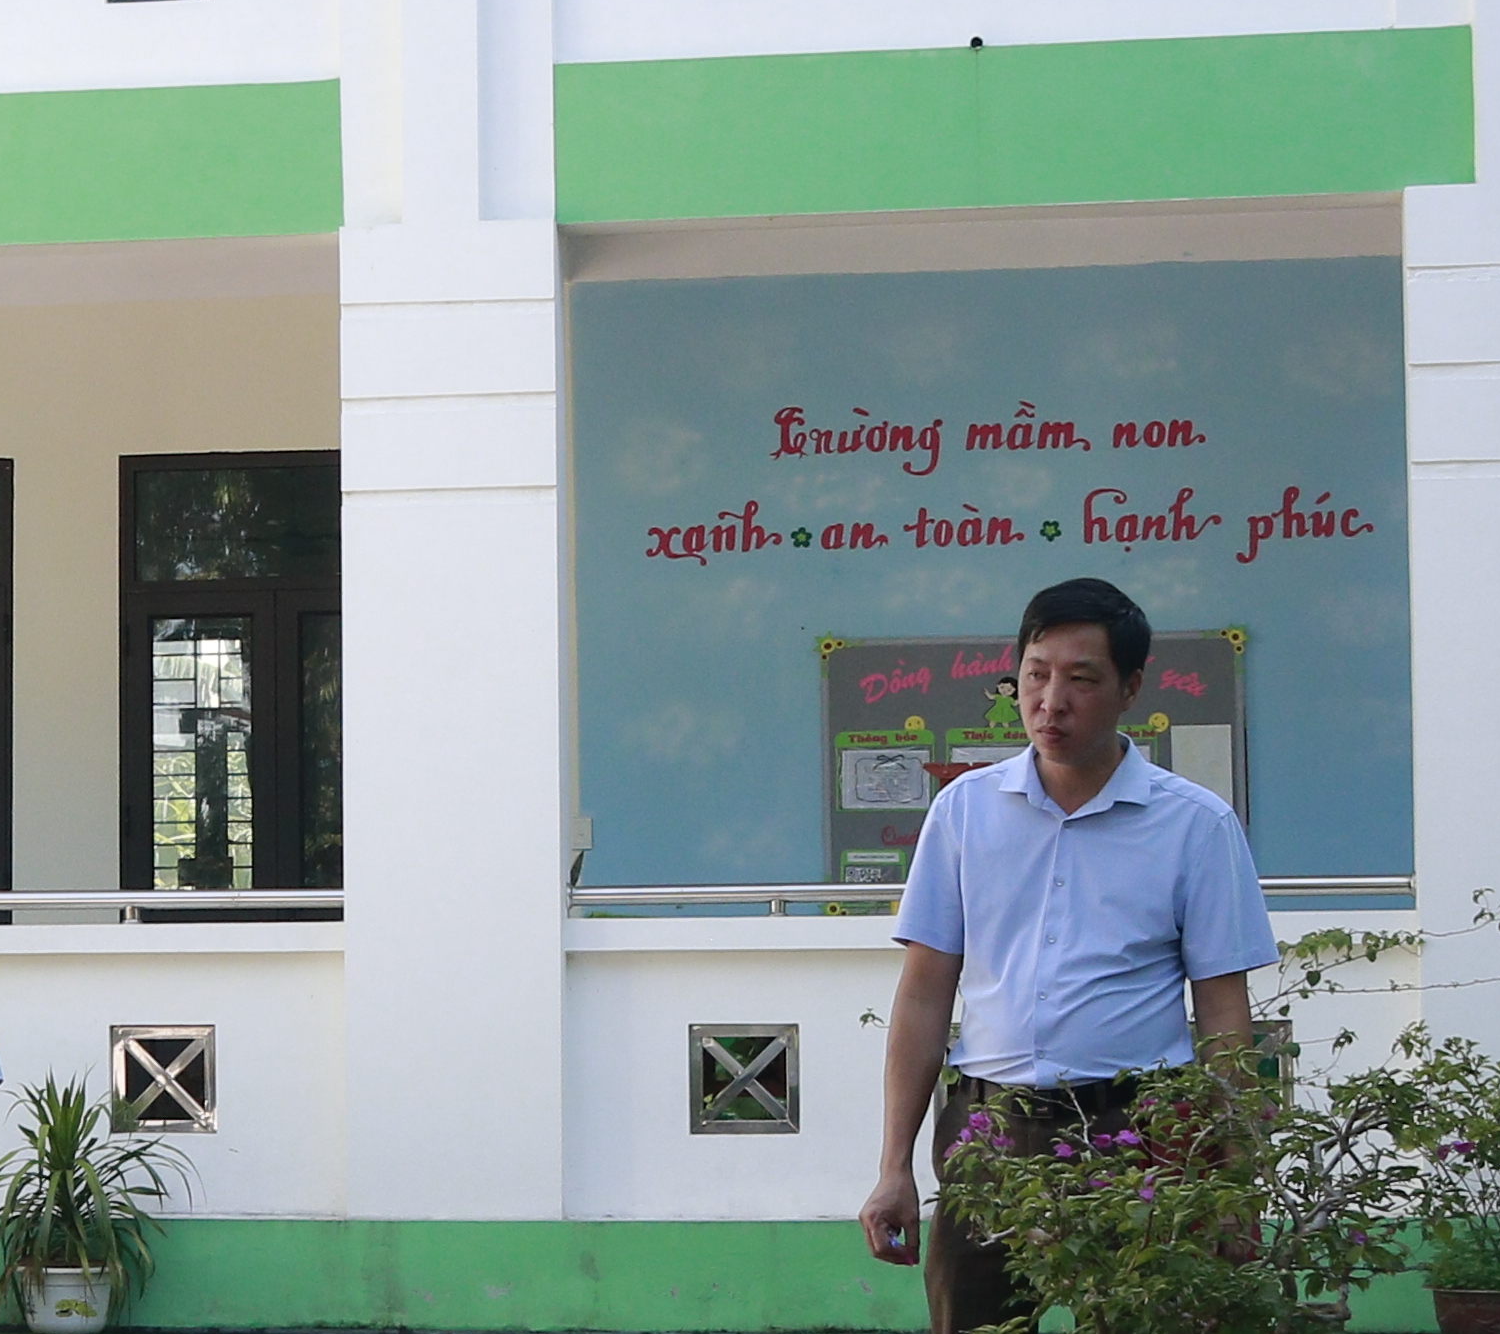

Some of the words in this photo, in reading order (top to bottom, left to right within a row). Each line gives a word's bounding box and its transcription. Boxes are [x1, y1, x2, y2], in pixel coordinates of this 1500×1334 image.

[966, 400, 1091, 451] mầm
[1112, 419, 1207, 448] non
[820, 522, 889, 550] an
[903, 503, 1025, 549] toàn
[1083, 487, 1223, 553] hạnh
[1236, 486, 1375, 564] phúc
[951, 644, 1015, 680] hành
